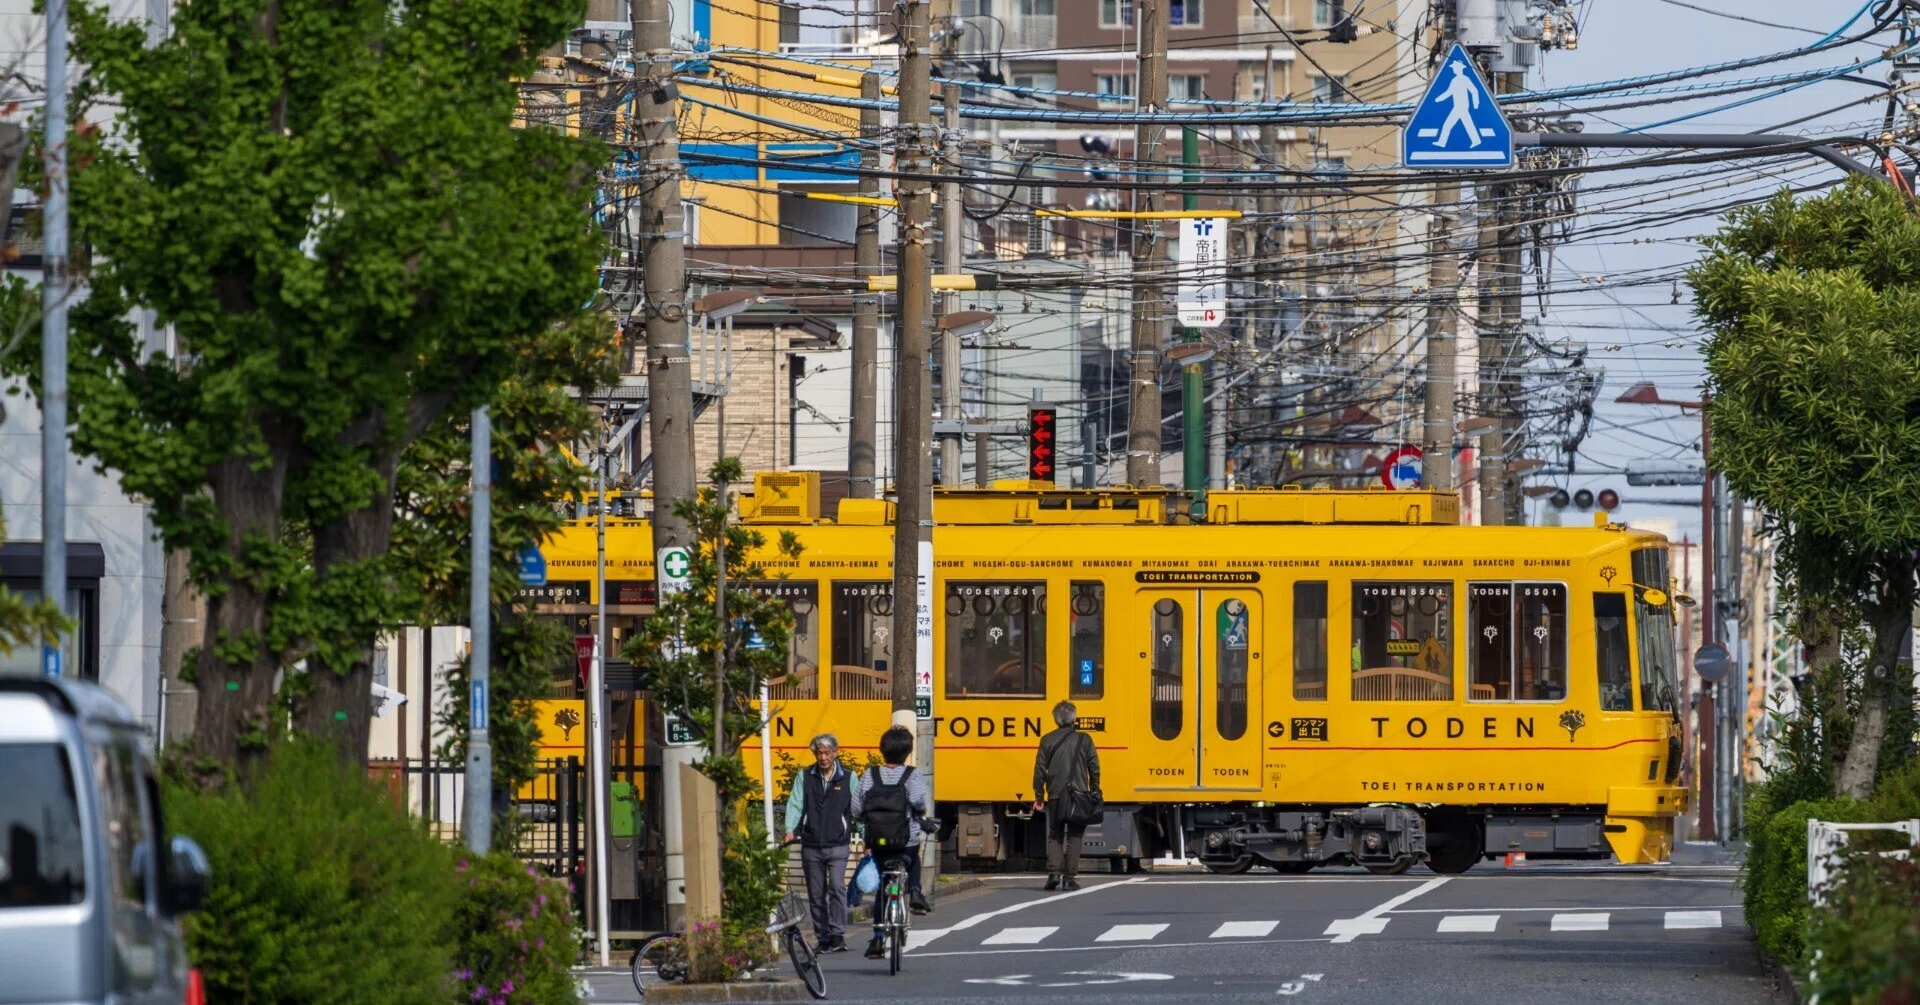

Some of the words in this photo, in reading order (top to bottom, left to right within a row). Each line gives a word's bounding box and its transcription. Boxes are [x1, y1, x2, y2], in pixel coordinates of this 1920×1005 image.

[809, 560, 879, 568] MACHIYA-EKIMAE
[973, 560, 1074, 568] HIGASHI-OGU-SANCHOME
[1329, 559, 1414, 567] ARAKAWA-SHAKOMAE
[1423, 559, 1464, 567] KAJIWARA
[1473, 559, 1515, 567] SAKAECHO
[1524, 559, 1571, 567] OJI-EKIMAE
[1143, 573, 1165, 581] TOEI
[1168, 573, 1252, 581] TRANSPORTATION
[776, 588, 808, 596] 8501
[843, 588, 885, 596] TODEN
[958, 588, 1000, 596] TODEN
[1004, 588, 1037, 596] 8501
[1363, 588, 1406, 596] TODEN
[1411, 588, 1443, 596] 8501
[1473, 588, 1509, 596] TODEN
[1525, 588, 1557, 596] 8501
[934, 717, 1041, 737] TODEN
[1295, 719, 1325, 727] ワンマン
[1299, 727, 1320, 736] 出口
[1371, 717, 1534, 738] TODEN
[1148, 768, 1185, 776] TODEN
[1213, 768, 1249, 776] TODEN
[1362, 782, 1396, 790] TOEI
[1405, 782, 1545, 791] TRANSPORTATION
